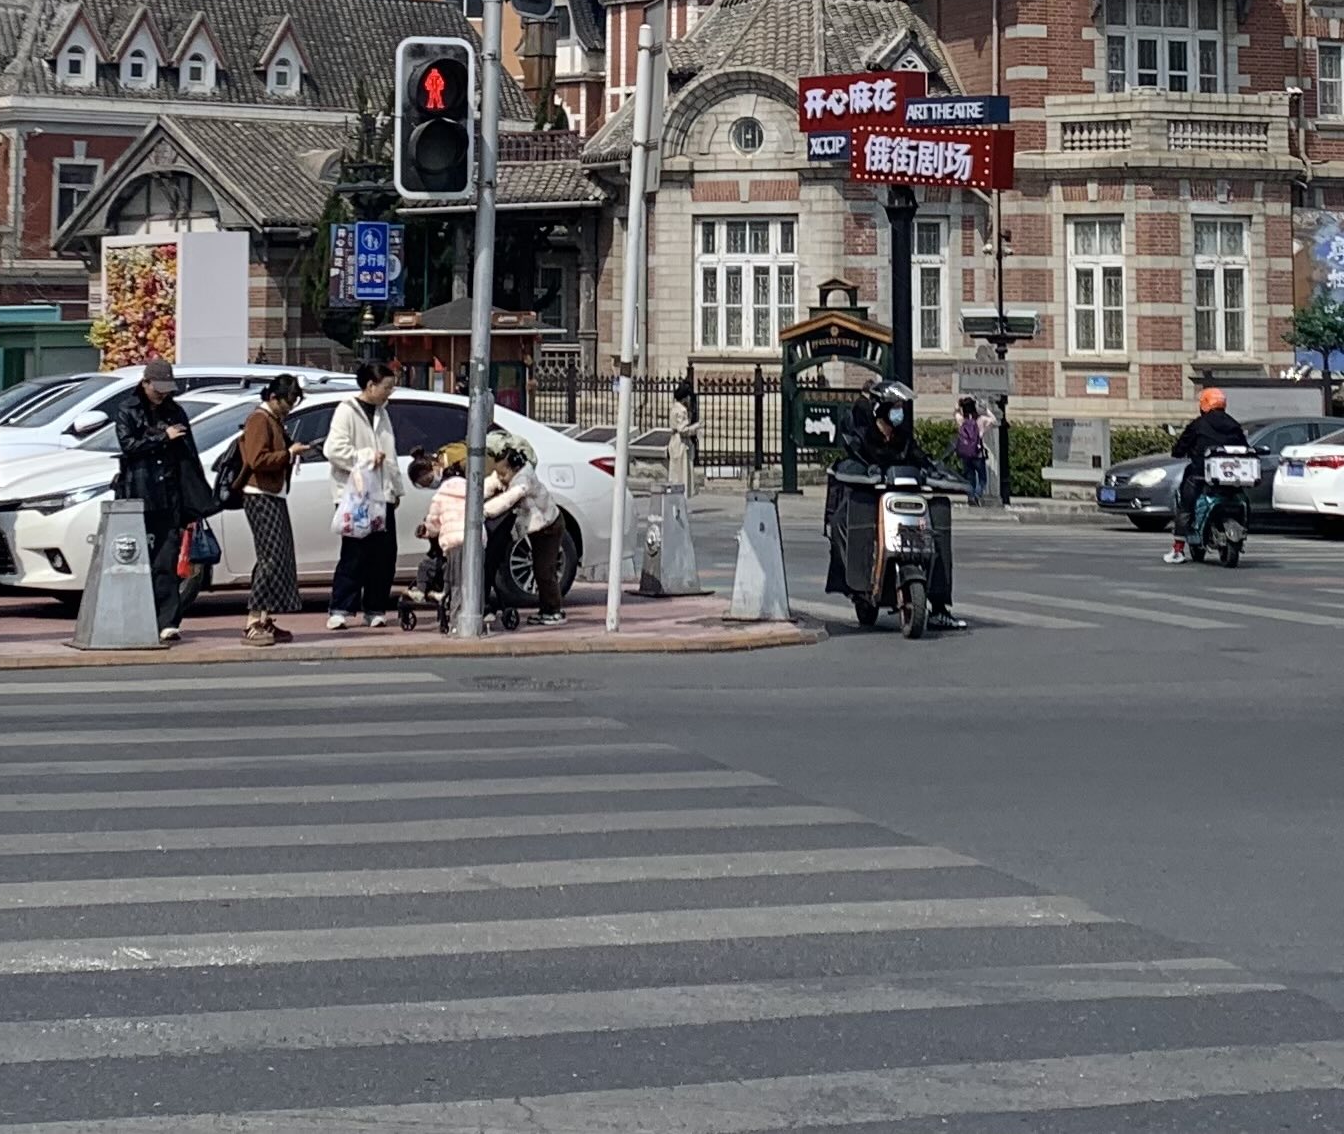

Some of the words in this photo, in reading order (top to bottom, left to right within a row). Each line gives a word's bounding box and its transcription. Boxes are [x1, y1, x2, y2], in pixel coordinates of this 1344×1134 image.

[804, 78, 897, 118] 开心麻花
[906, 104, 929, 120] ART
[930, 102, 985, 120] THEATRE
[864, 134, 974, 181] 俄街剧场
